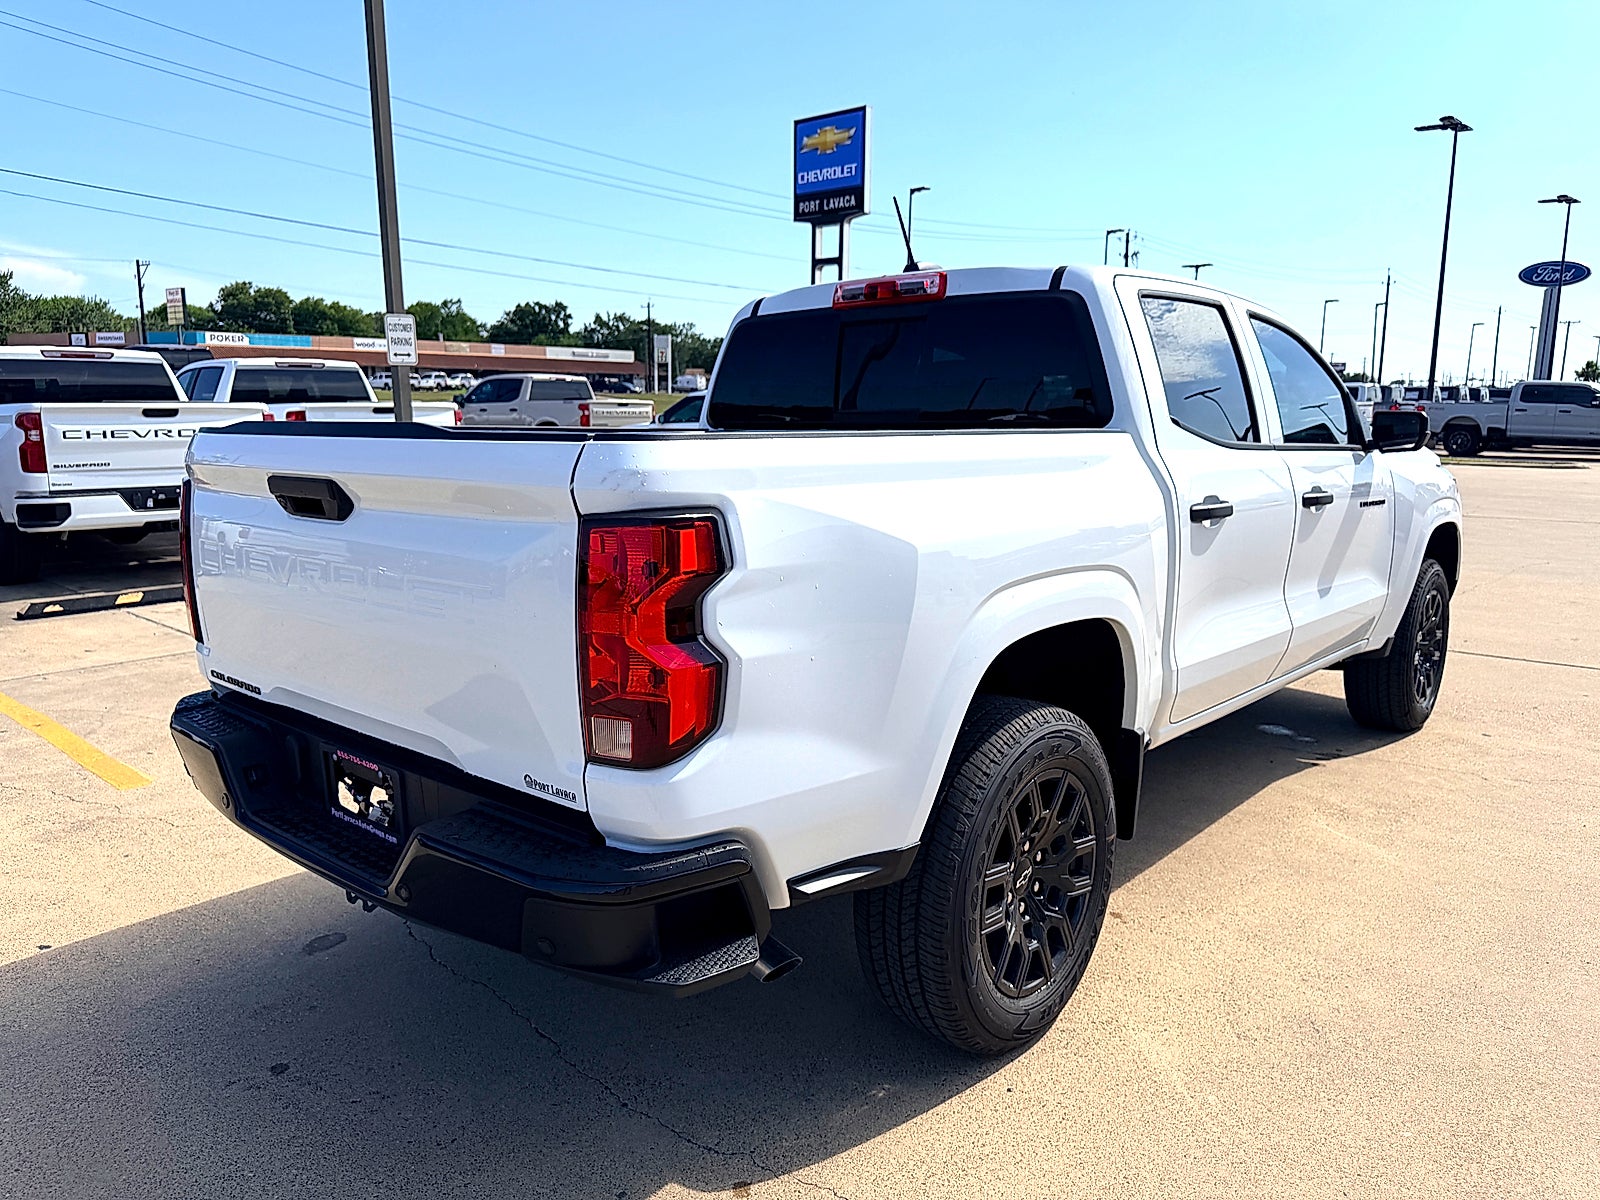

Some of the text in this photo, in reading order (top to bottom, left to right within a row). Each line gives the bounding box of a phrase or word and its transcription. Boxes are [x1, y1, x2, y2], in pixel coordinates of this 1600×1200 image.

[798, 163, 857, 184] CHEVROLET
[799, 195, 856, 213] PORT LAVACA
[1532, 265, 1575, 282] Ford
[388, 323, 412, 333] CUSTOMER
[209, 334, 245, 343] POKER
[390, 336, 413, 347] PARKING
[62, 429, 196, 440] CHEVRO
[210, 669, 262, 696] COLORADO
[533, 778, 550, 793] PORT
